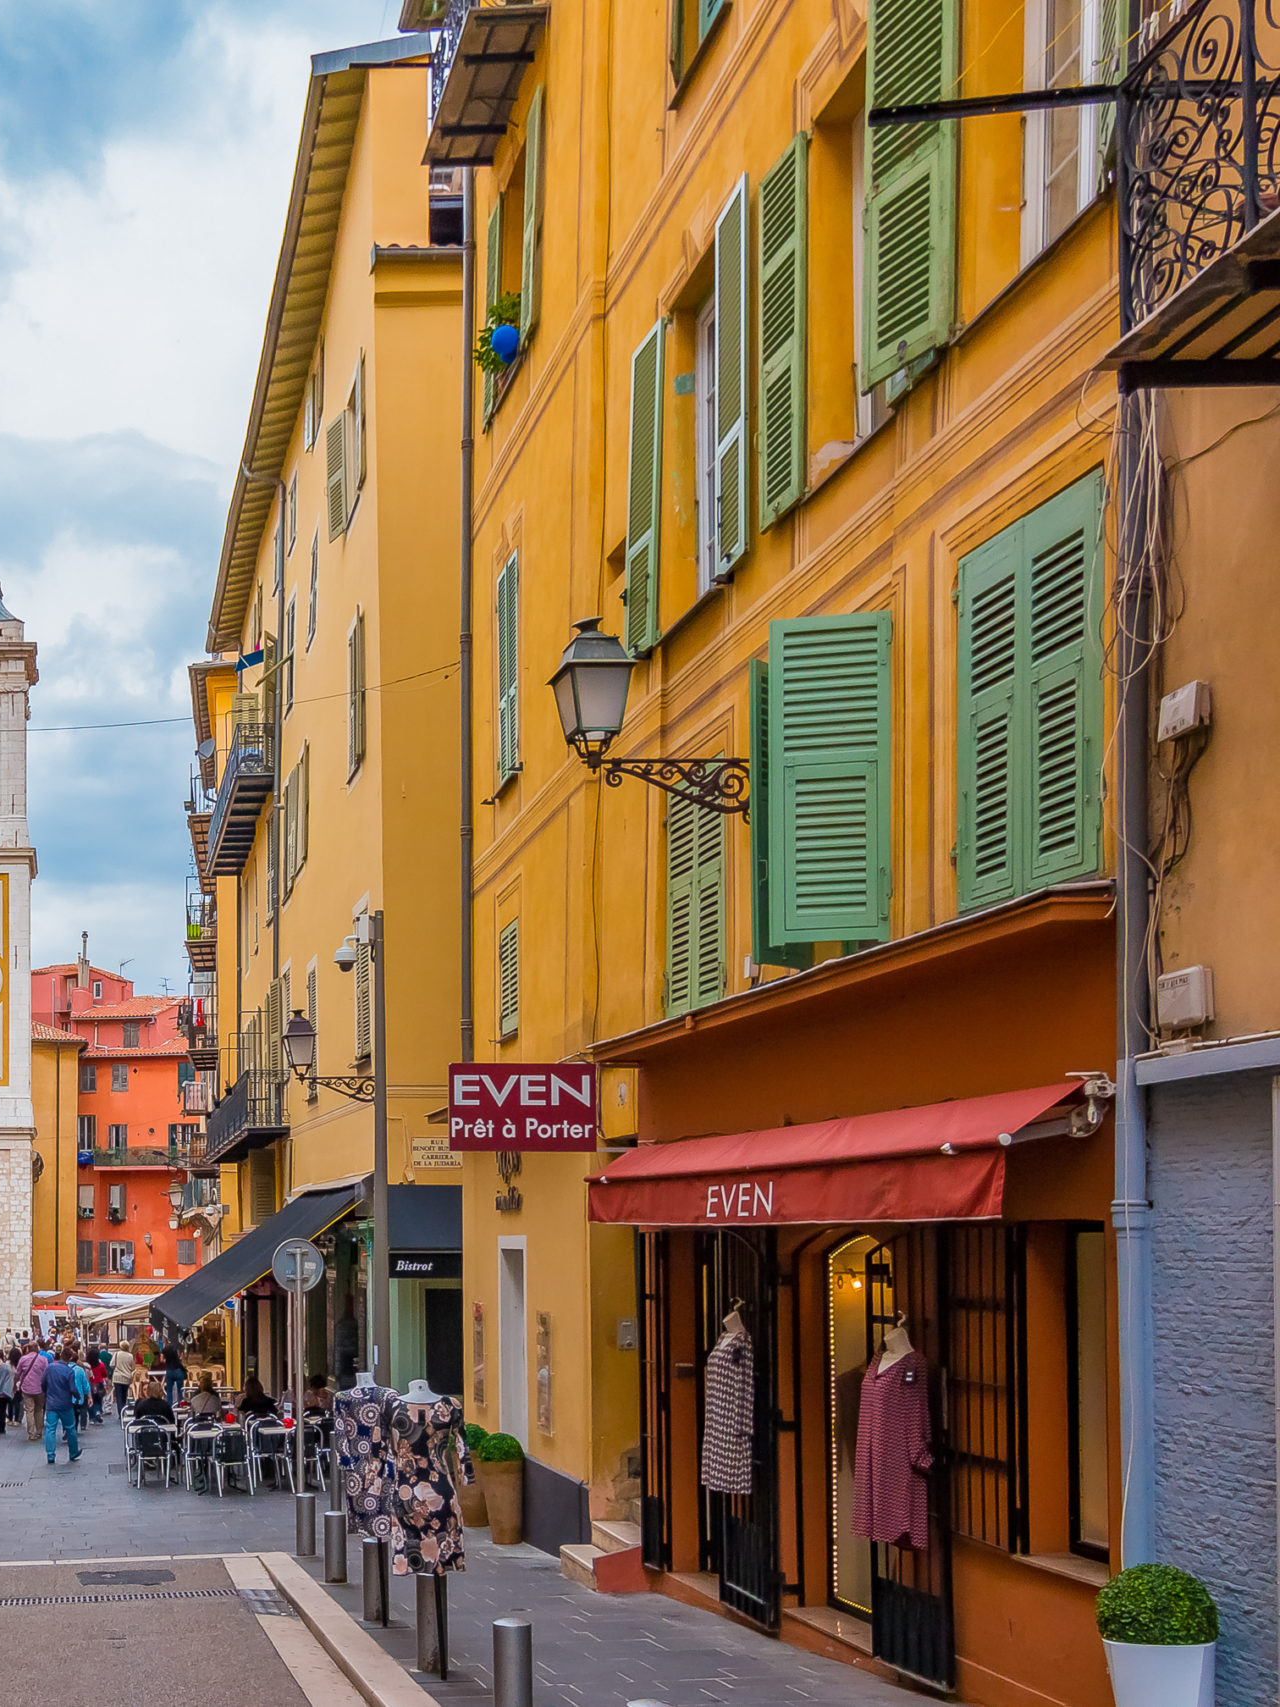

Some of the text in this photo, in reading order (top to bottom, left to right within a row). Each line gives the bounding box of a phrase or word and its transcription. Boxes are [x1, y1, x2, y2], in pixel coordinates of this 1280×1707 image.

[453, 1073, 591, 1108] EVEN
[451, 1117, 593, 1139] Prêt à Porter
[706, 1180, 773, 1218] EVEN
[395, 1260, 434, 1271] Bistrot
